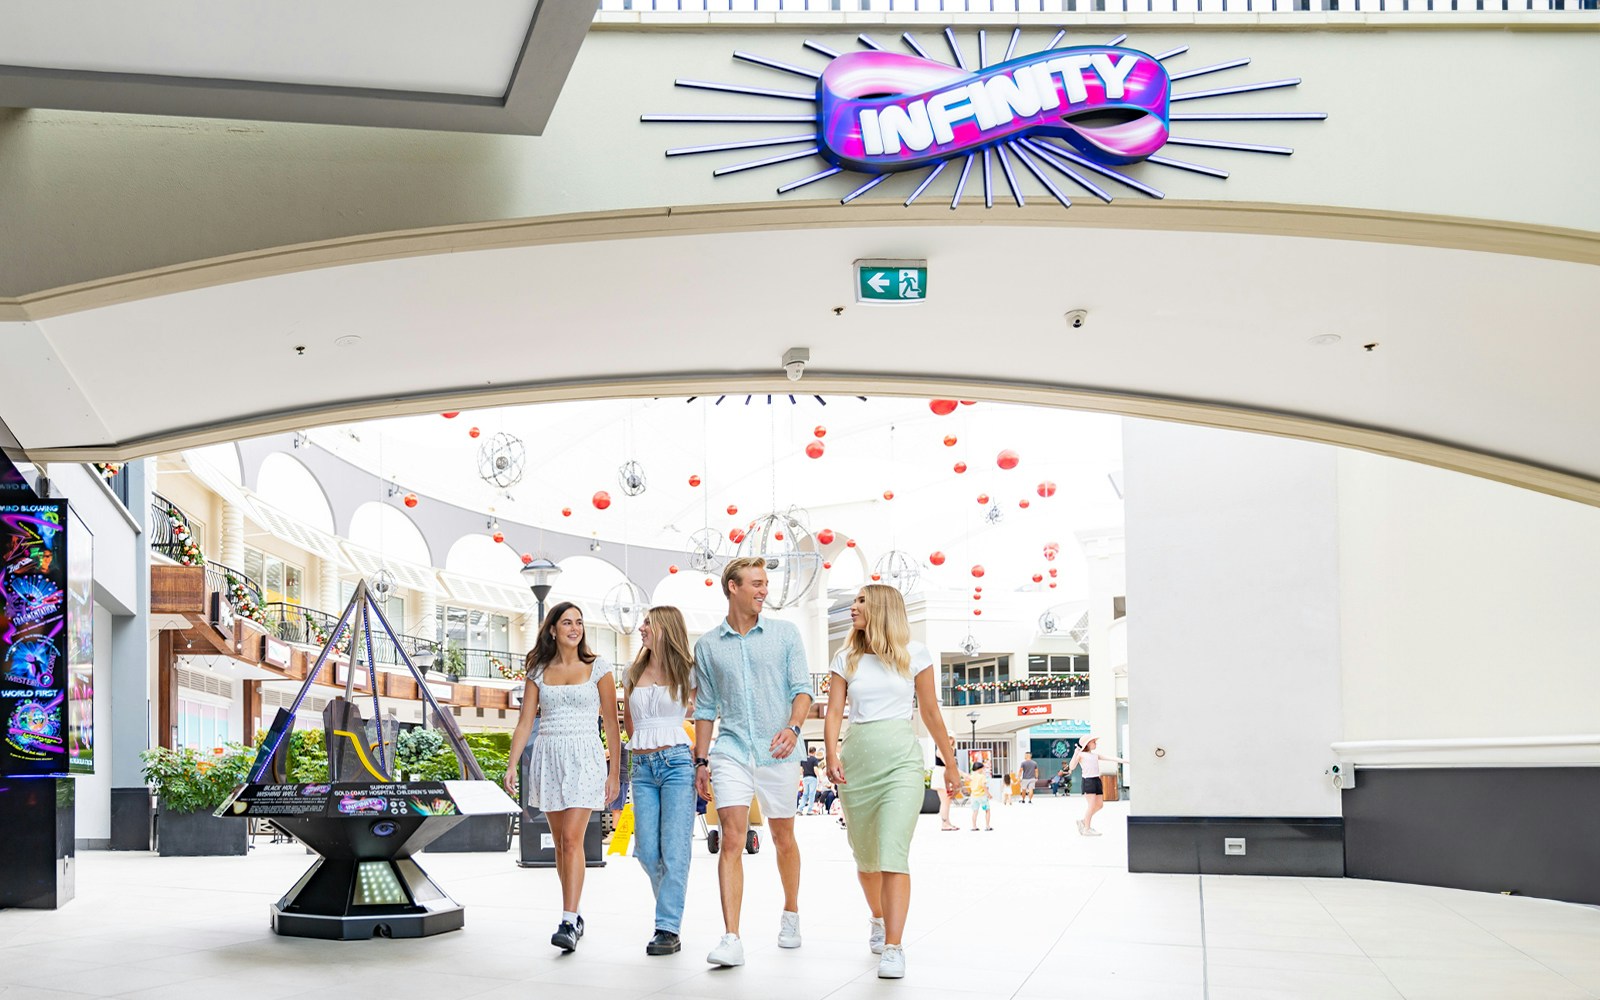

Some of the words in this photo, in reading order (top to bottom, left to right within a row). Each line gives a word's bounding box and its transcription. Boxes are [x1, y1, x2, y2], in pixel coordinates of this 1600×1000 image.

[859, 54, 1139, 155] INFINITY
[1, 689, 34, 698] WORLD
[34, 689, 58, 698] FIRST
[1029, 706, 1048, 714] coles
[345, 799, 379, 810] INFINITY
